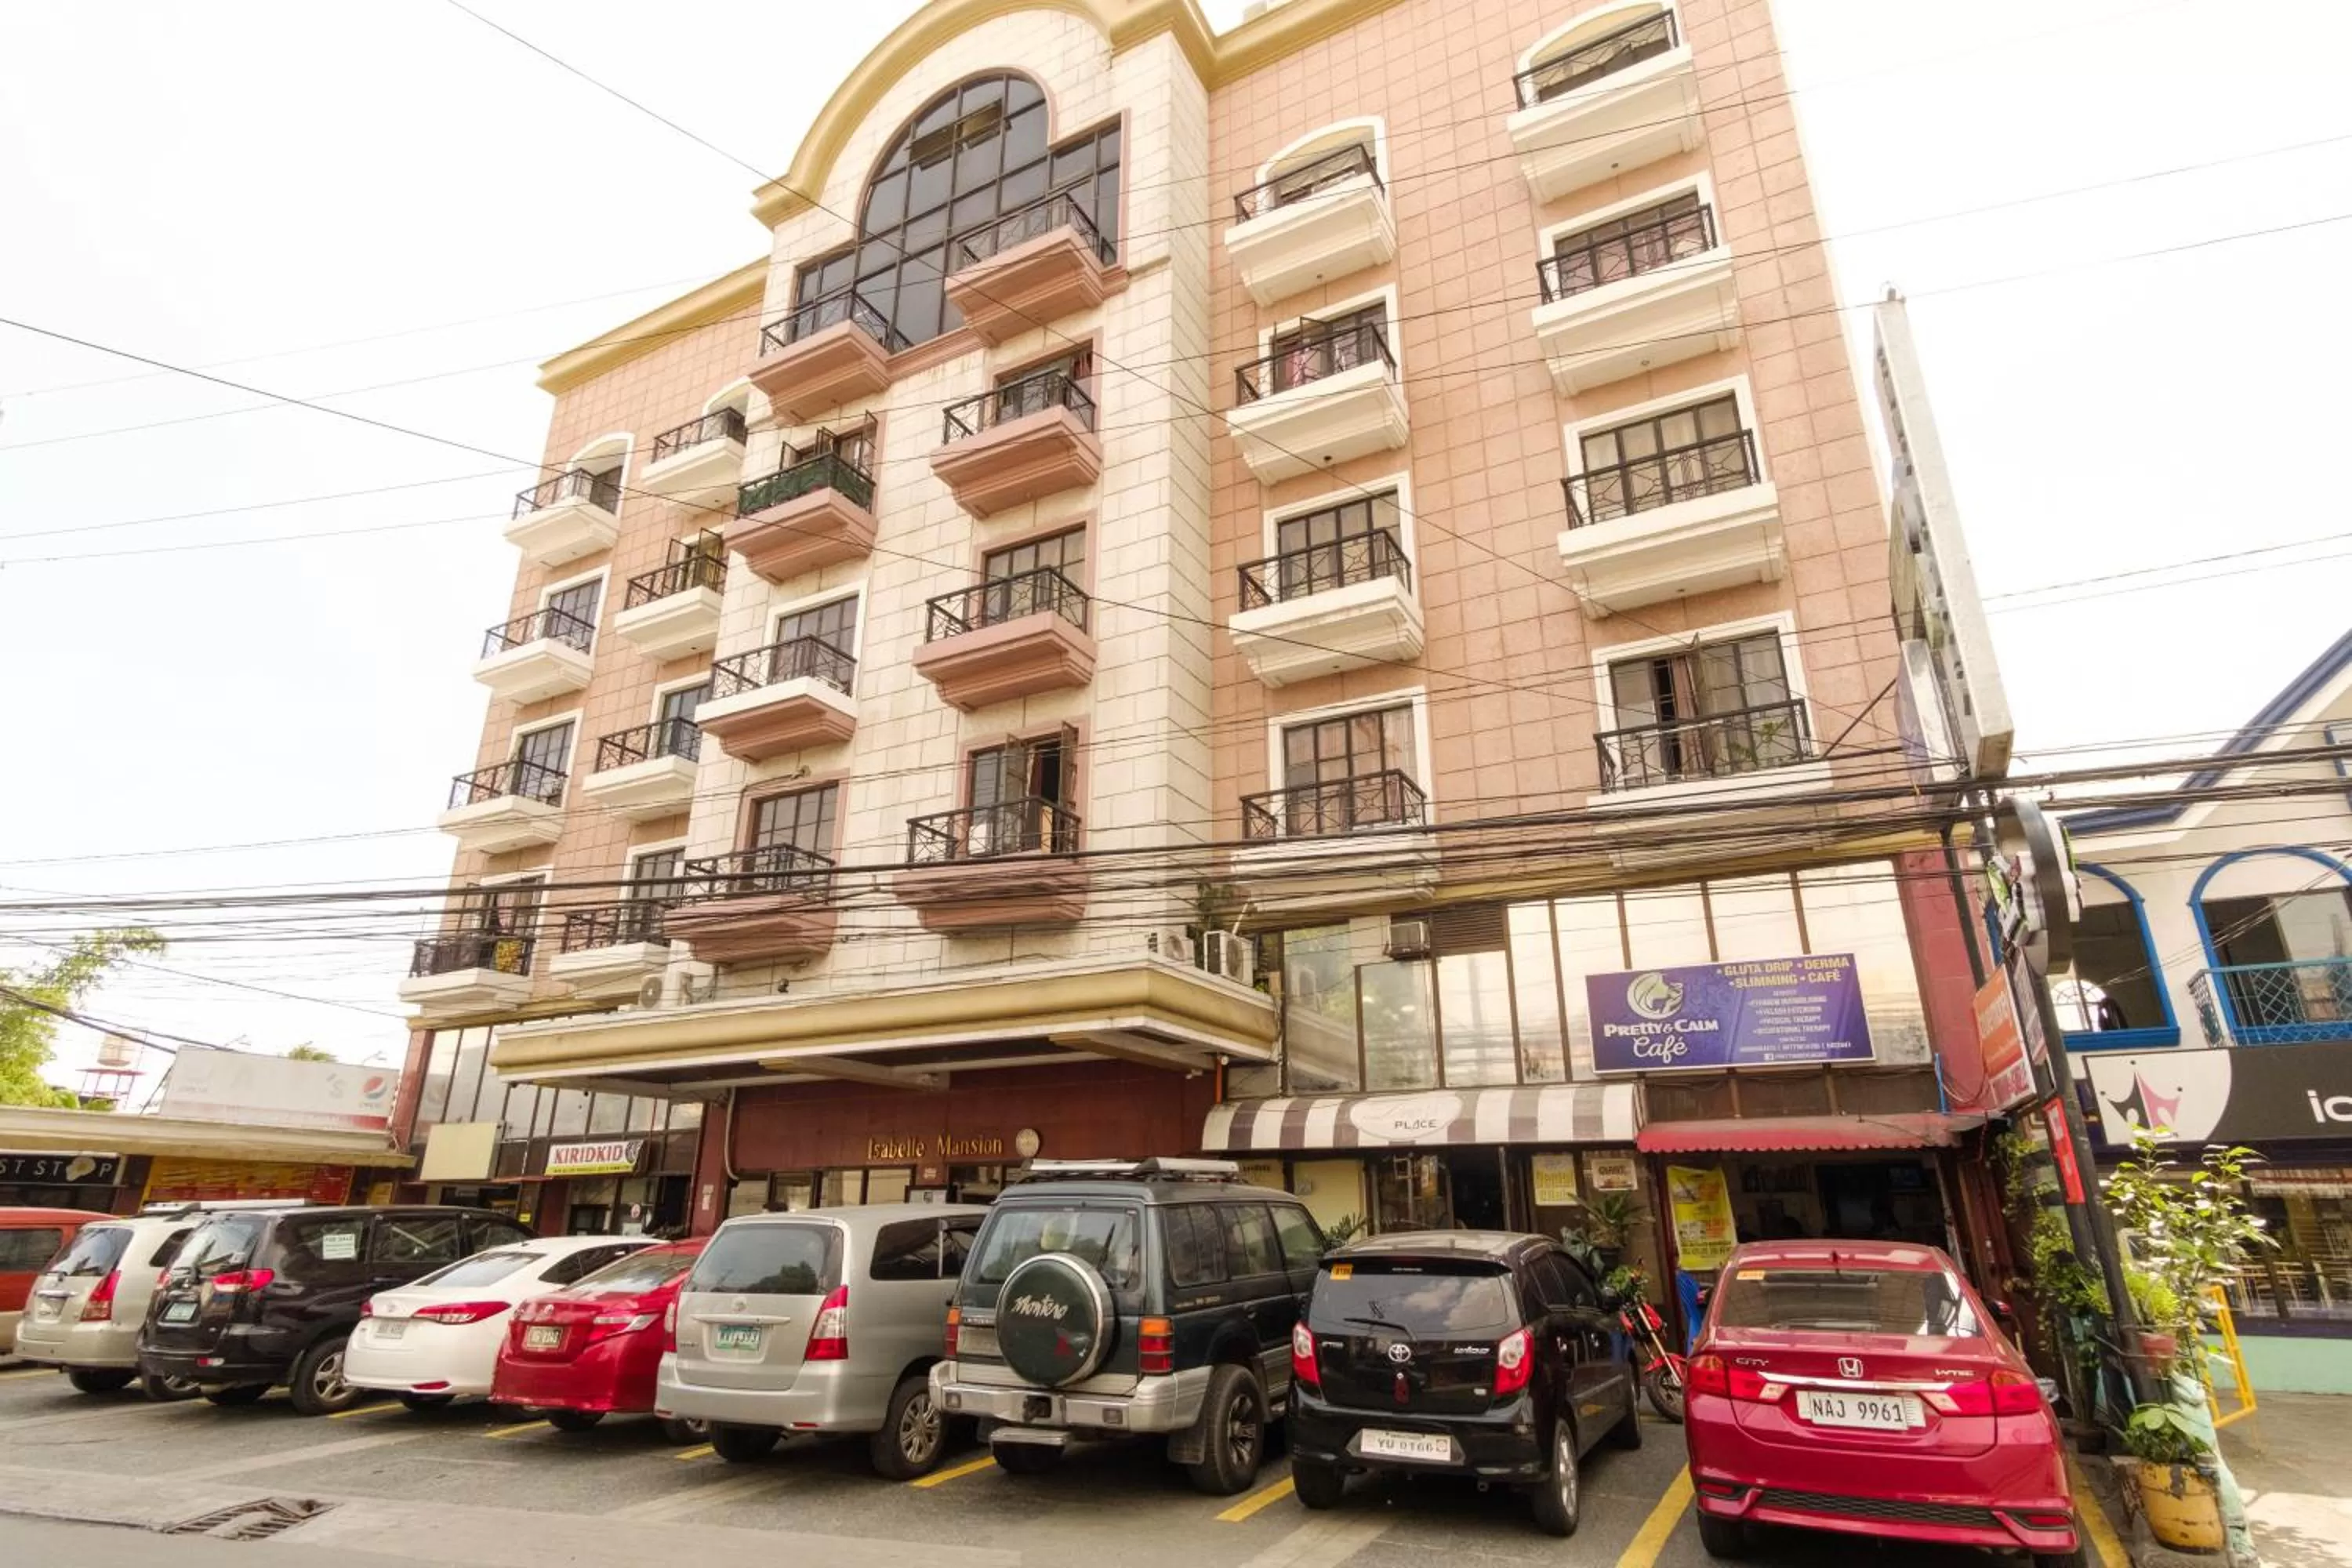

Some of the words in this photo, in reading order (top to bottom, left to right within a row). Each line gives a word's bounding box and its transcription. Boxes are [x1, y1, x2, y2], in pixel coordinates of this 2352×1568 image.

[1725, 964, 1762, 976] GLUTA
[1765, 960, 1793, 973] DRIP
[1805, 957, 1849, 970] DERMA
[1735, 974, 1798, 989] SLIMMING
[1633, 1034, 1687, 1064] Café
[554, 1145, 623, 1164] KIRIDKID
[867, 1136, 925, 1160] Isabelle
[937, 1134, 1003, 1156] Mansion
[1011, 1294, 1069, 1319] Montero
[1812, 1399, 1846, 1420] NAJ
[1857, 1401, 1904, 1423] 9961
